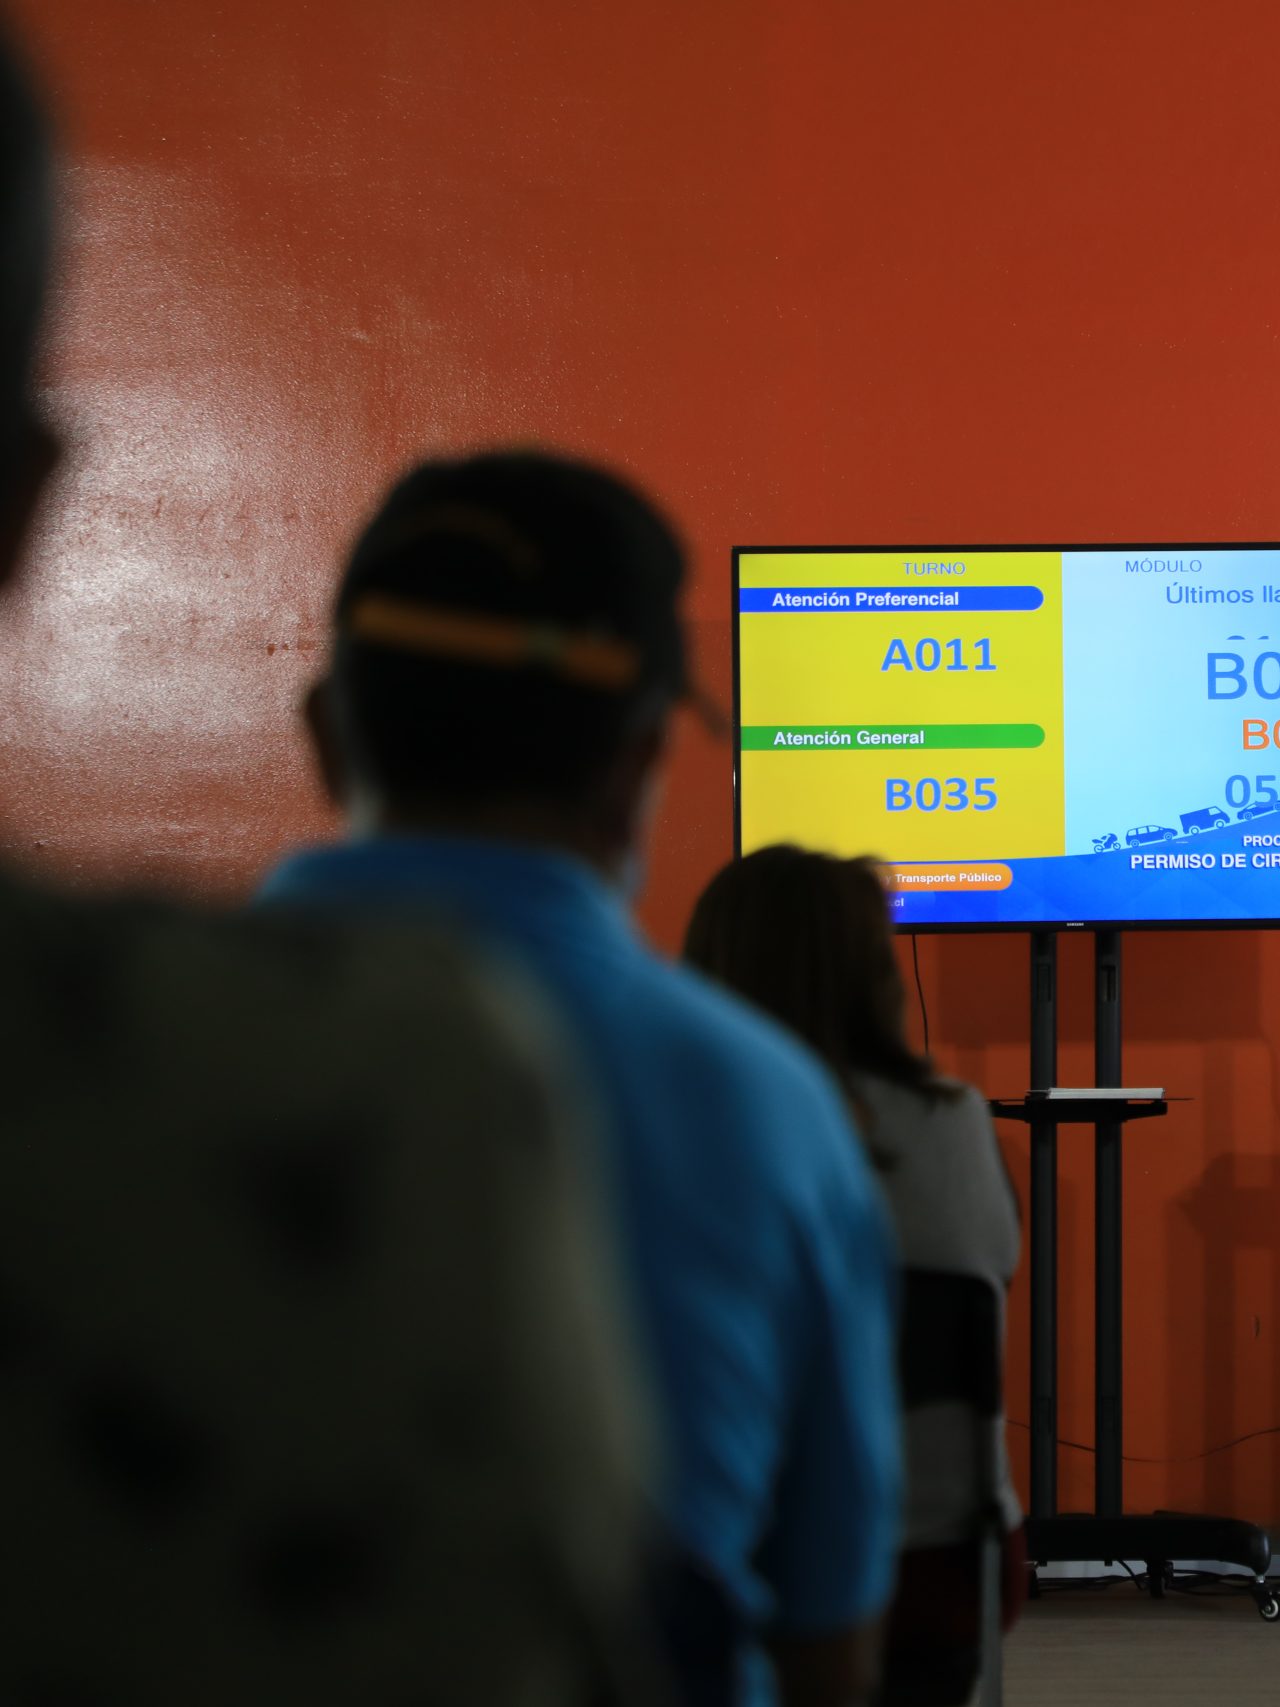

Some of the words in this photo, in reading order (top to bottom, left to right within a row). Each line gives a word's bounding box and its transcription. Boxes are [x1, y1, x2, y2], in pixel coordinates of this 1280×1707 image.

[903, 561, 966, 575] TURNO
[1125, 558, 1202, 573] MÓDULO
[772, 591, 850, 607] Atención
[855, 591, 959, 607] Preferencial
[1166, 582, 1254, 604] Últimos
[880, 637, 996, 672] A011
[773, 730, 851, 745] Atención
[857, 730, 924, 745] General
[885, 777, 997, 812] B035
[1225, 774, 1279, 808] 05
[1130, 854, 1215, 869] PERMISO
[1221, 854, 1246, 868] DE
[896, 873, 956, 884] Transporte
[960, 873, 1002, 882] Público
